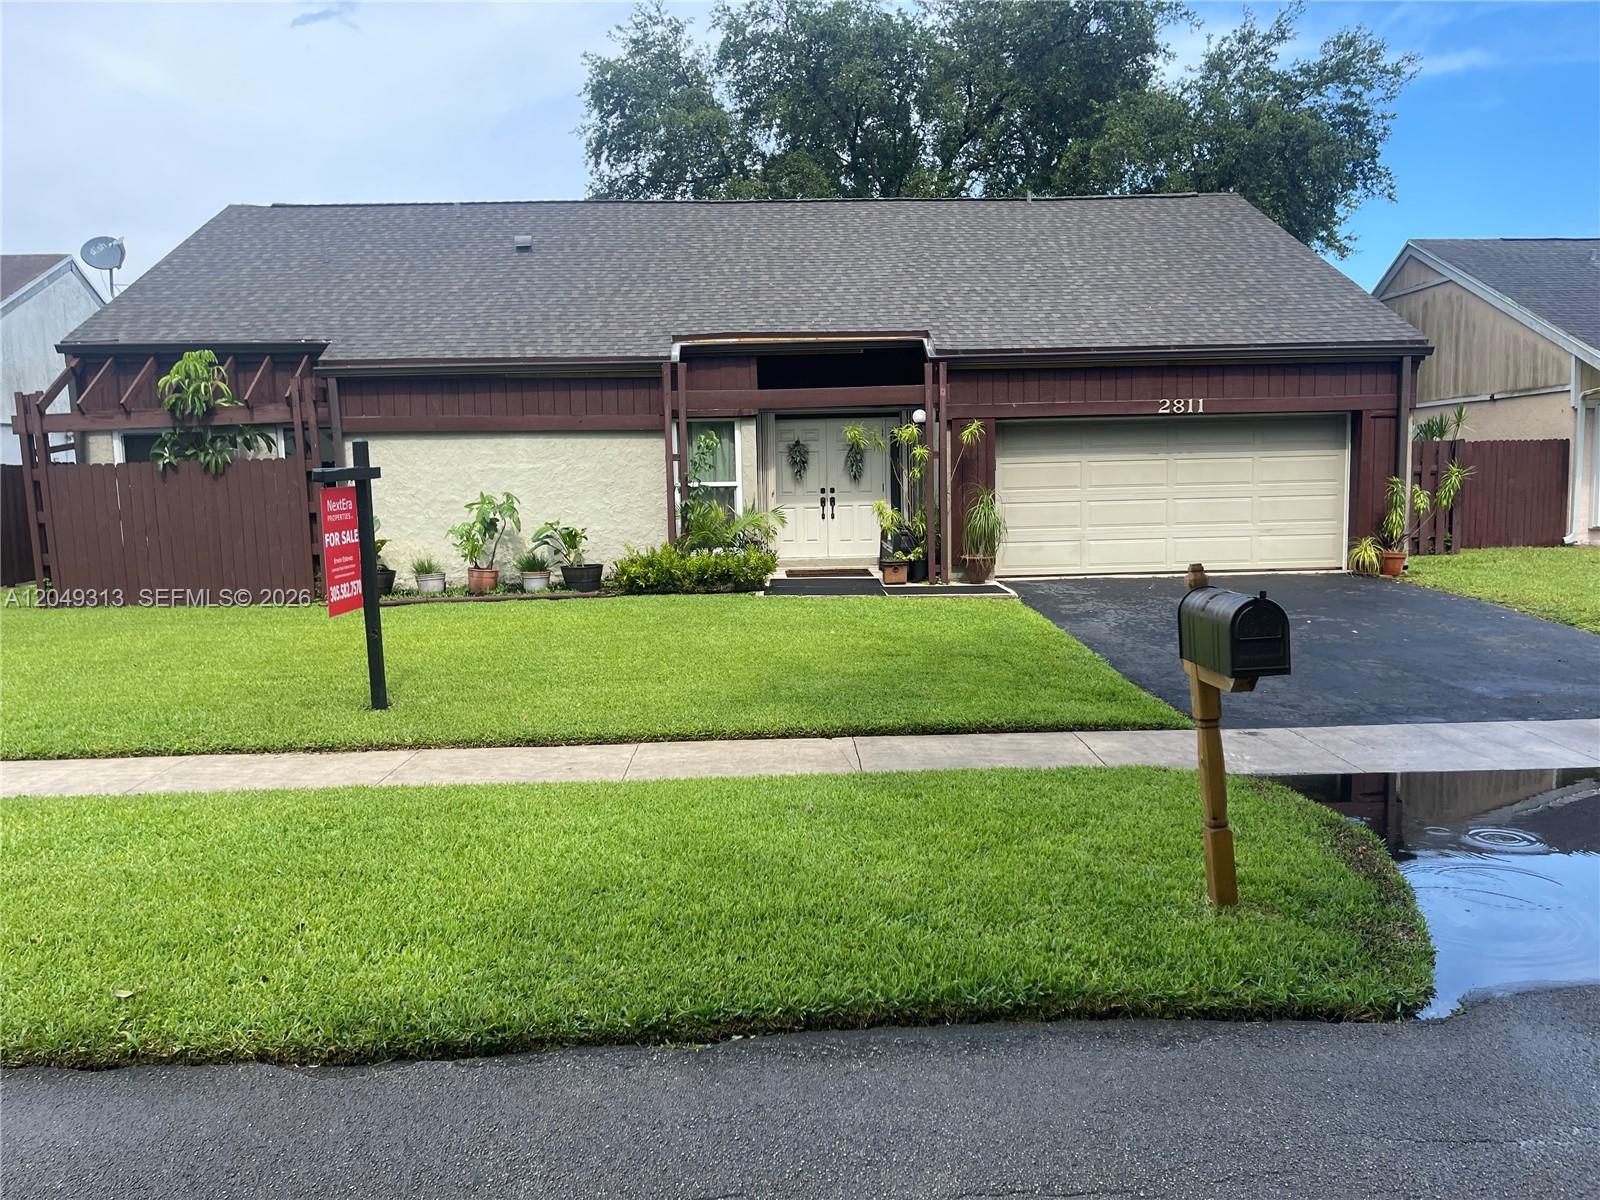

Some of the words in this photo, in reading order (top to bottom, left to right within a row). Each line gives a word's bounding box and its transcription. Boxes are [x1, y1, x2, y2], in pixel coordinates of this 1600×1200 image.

[1158, 398, 1204, 413] 2811
[327, 498, 352, 512] NextEra
[327, 512, 351, 522] PROPERTIES
[324, 533, 340, 548] FOR
[341, 529, 359, 544] SALE
